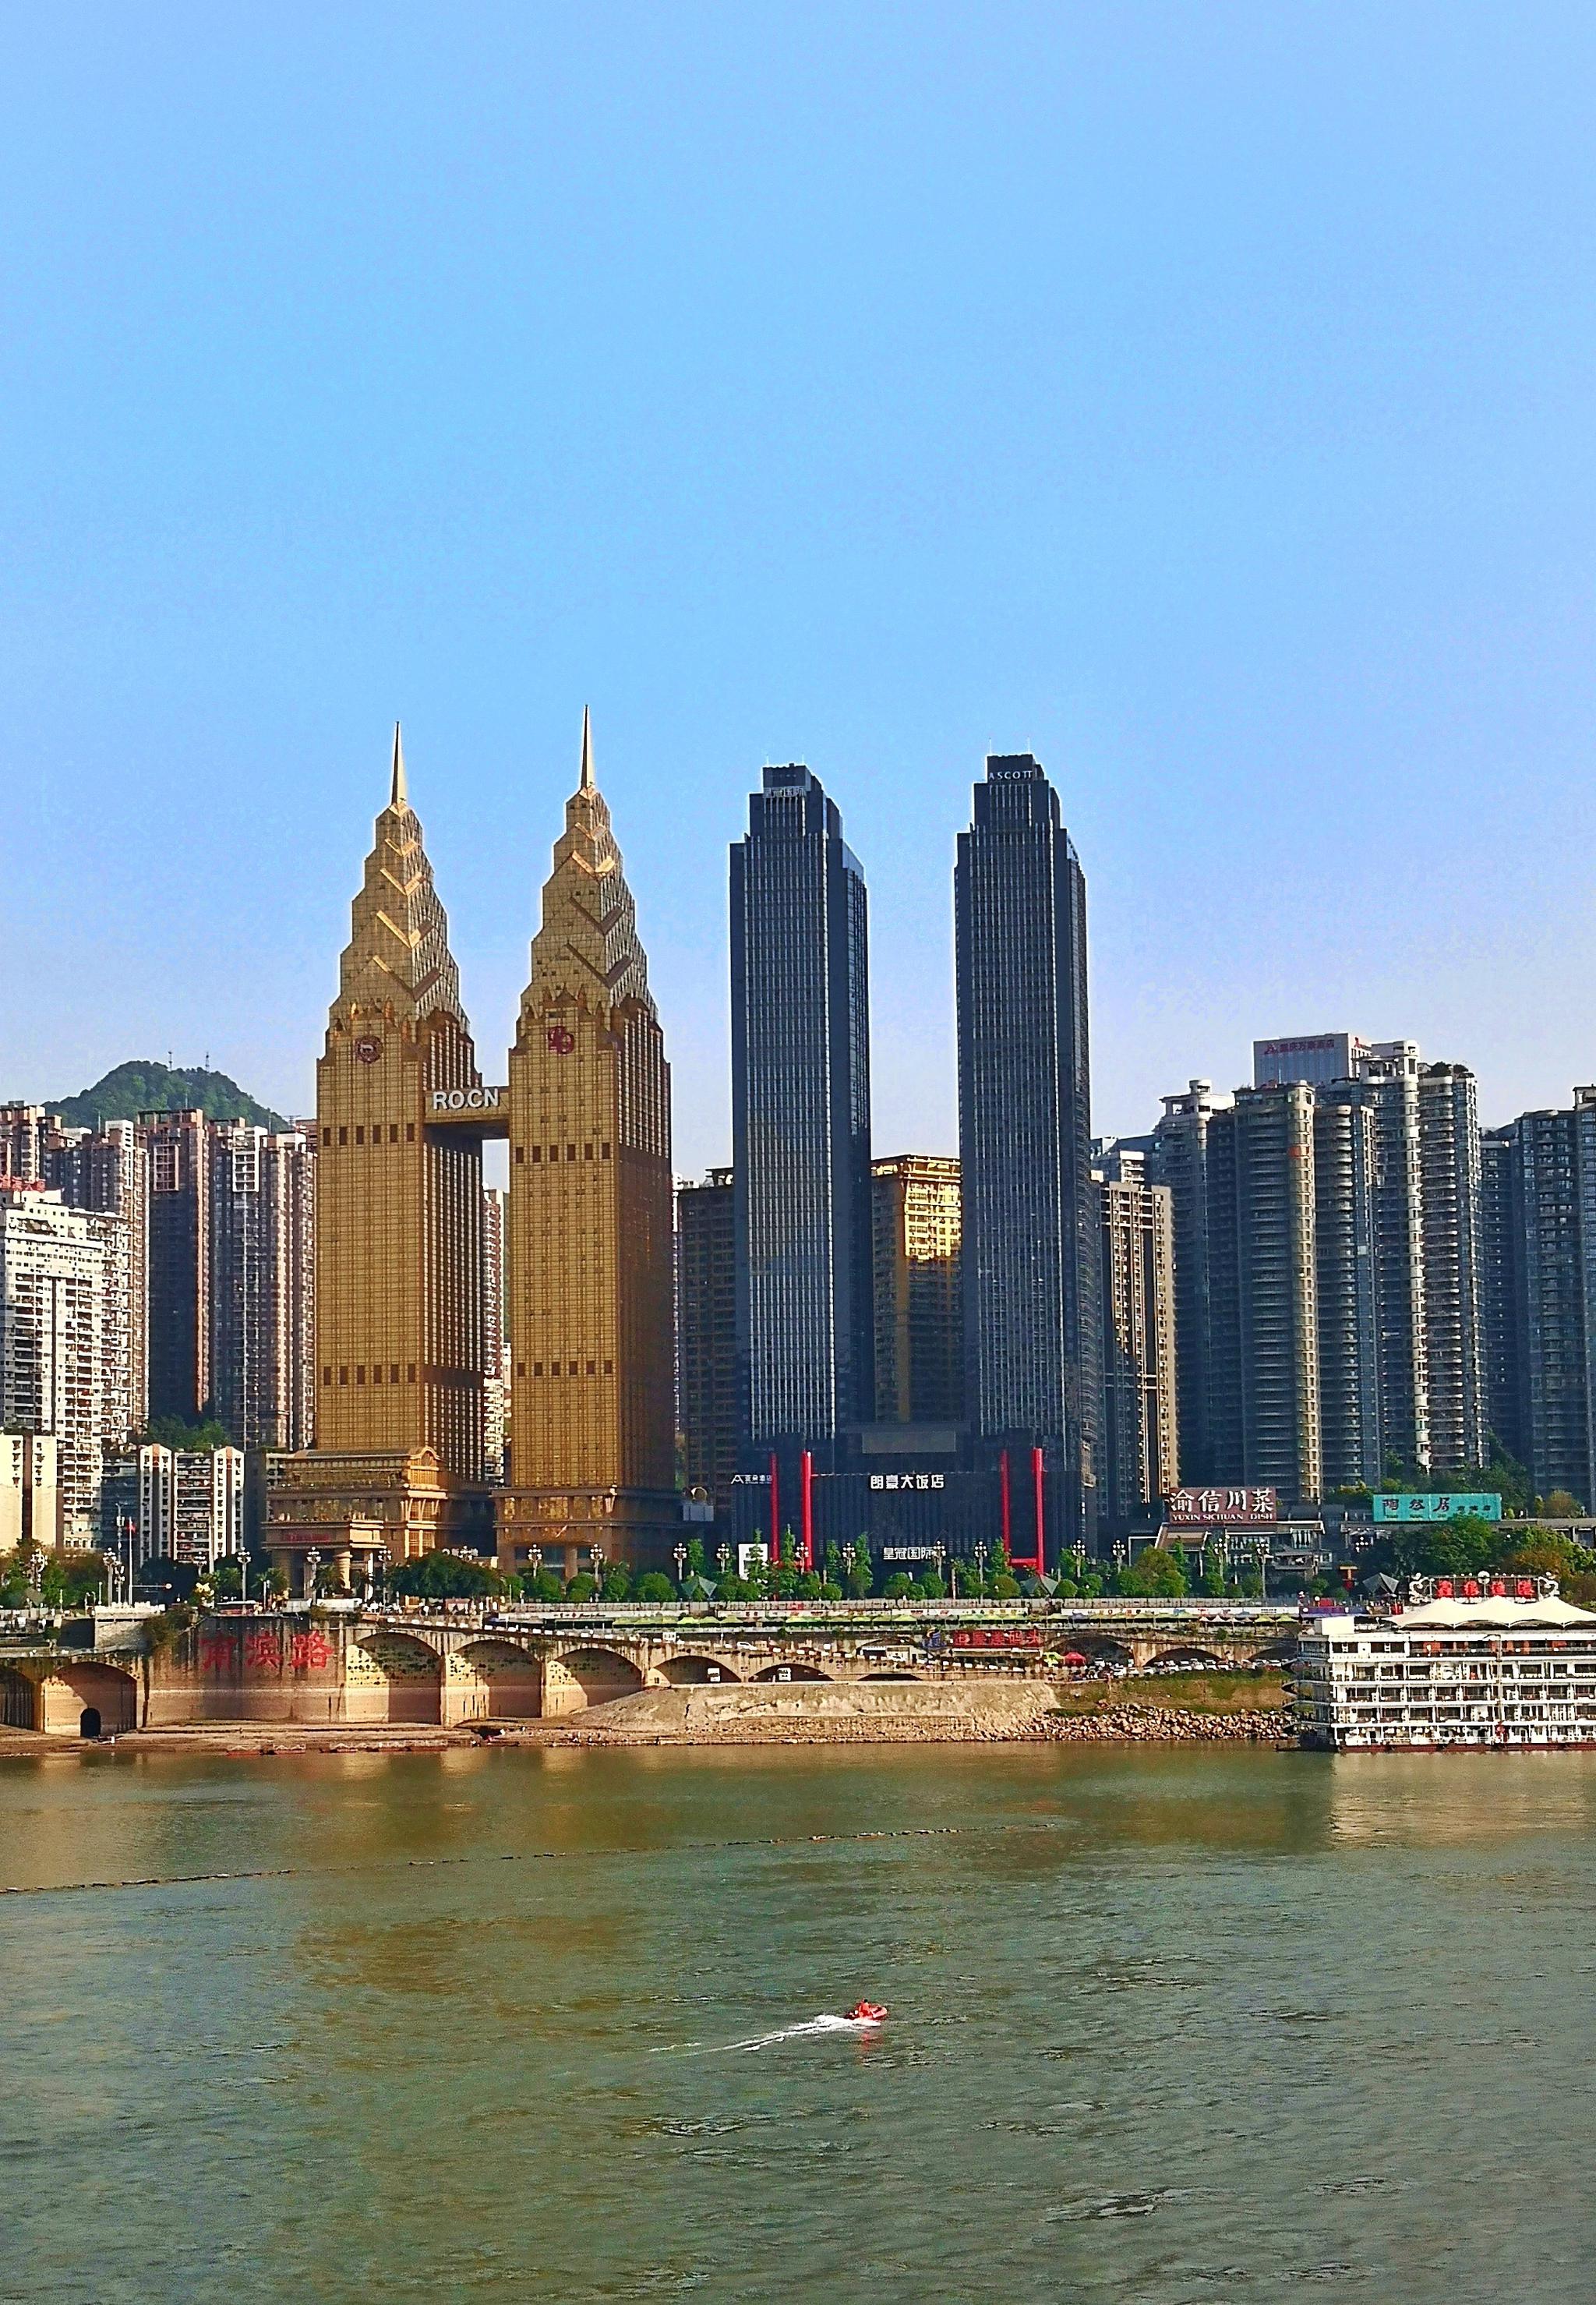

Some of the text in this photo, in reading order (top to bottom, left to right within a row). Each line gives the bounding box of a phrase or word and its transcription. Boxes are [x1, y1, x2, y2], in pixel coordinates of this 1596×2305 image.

[988, 770, 1033, 780] ASCOTT
[870, 1474, 945, 1490] 朗豪大饭店
[1170, 1488, 1275, 1512] 渝信川菜
[883, 1547, 935, 1560] 皇冠国际
[200, 1630, 334, 1670] 南滨路
